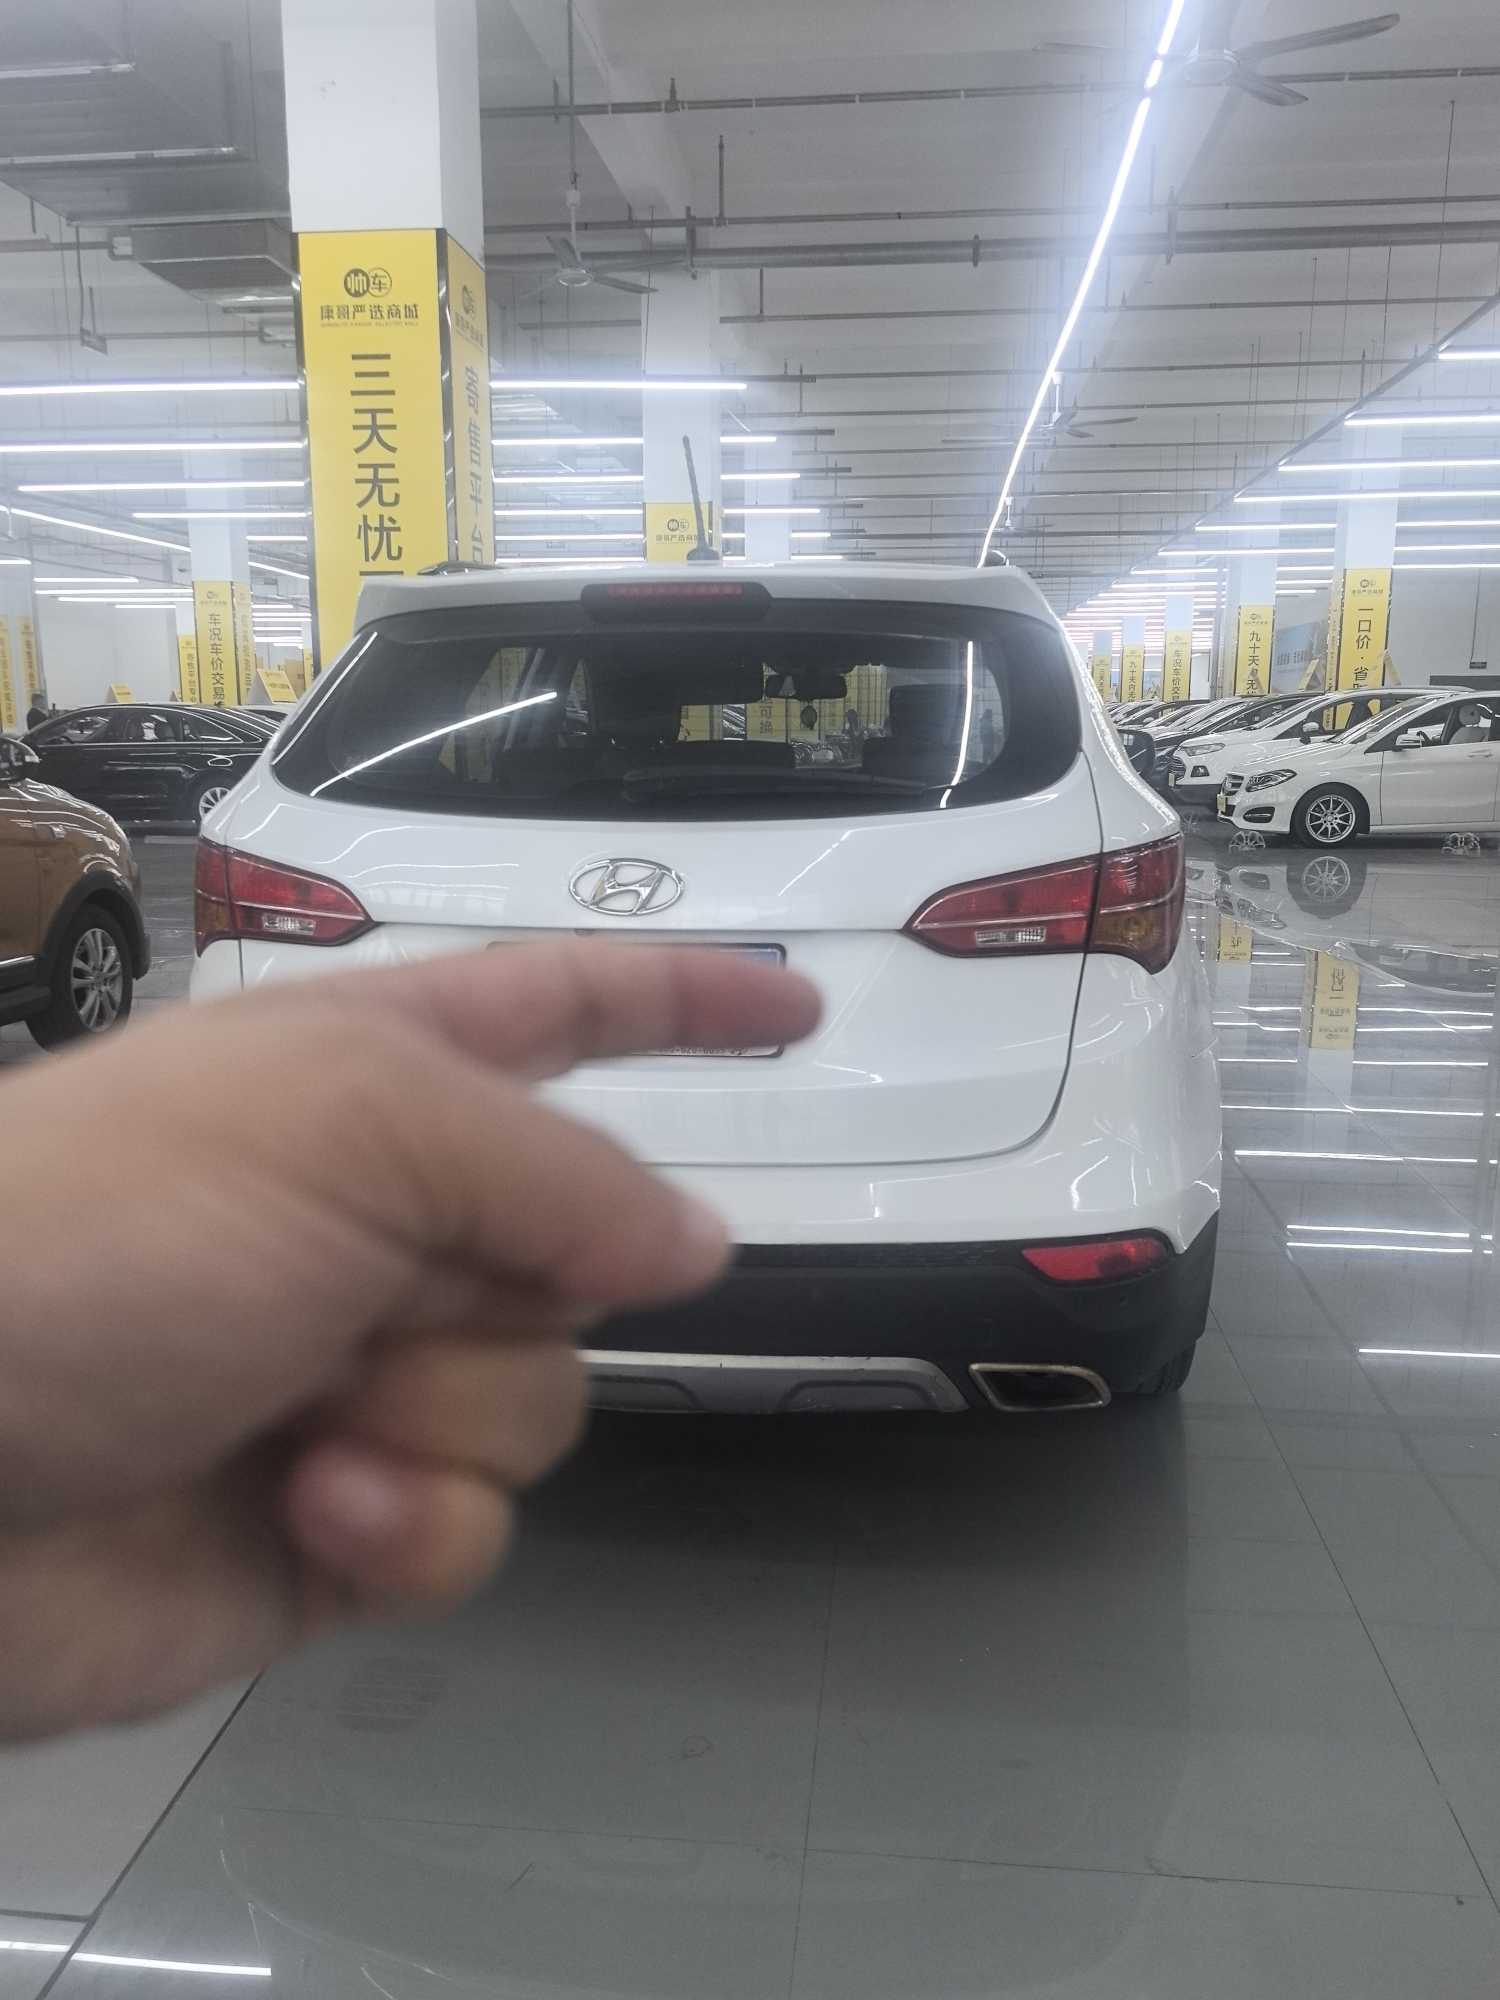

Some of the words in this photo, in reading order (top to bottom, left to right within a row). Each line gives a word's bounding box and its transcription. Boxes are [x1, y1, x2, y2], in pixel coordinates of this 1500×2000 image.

[350, 353, 404, 576] 三天无忧
[1246, 630, 1261, 694] 九十天无
